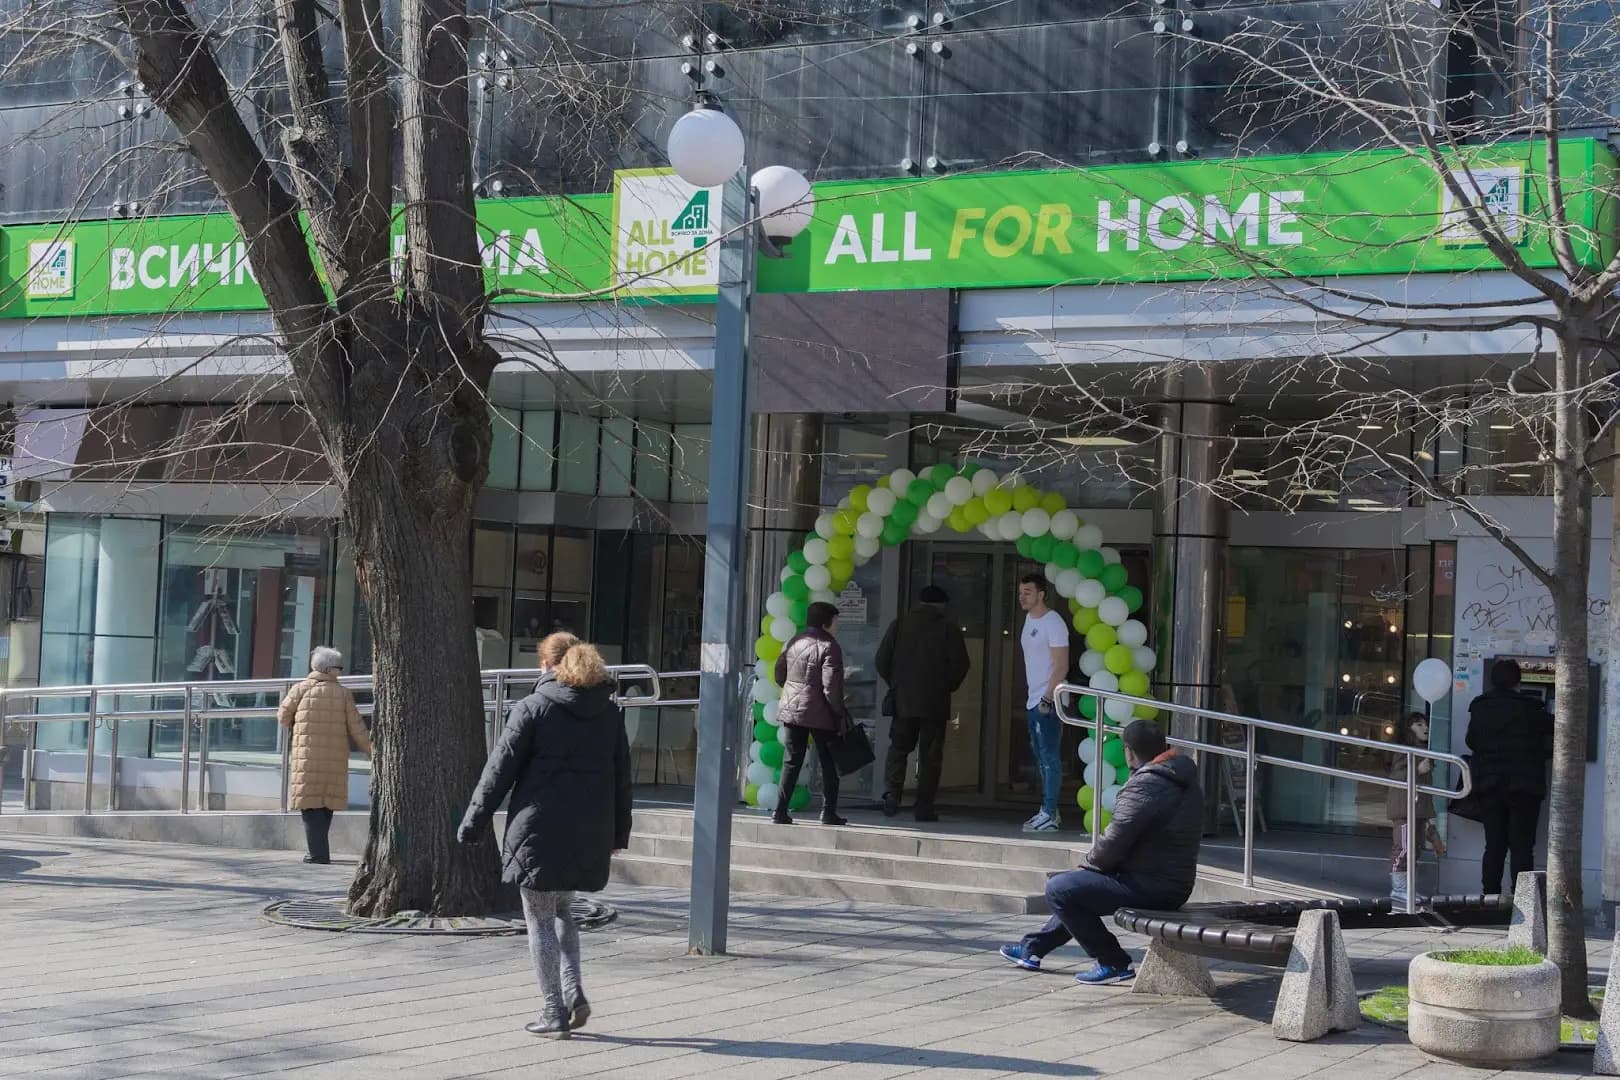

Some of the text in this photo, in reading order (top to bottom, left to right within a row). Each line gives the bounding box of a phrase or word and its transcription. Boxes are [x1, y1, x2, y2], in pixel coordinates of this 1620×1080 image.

[626, 219, 675, 246] ALL
[823, 190, 1306, 264] ALL FOR HOME
[110, 241, 258, 290] ВСИЧК
[625, 250, 707, 277] HOME
